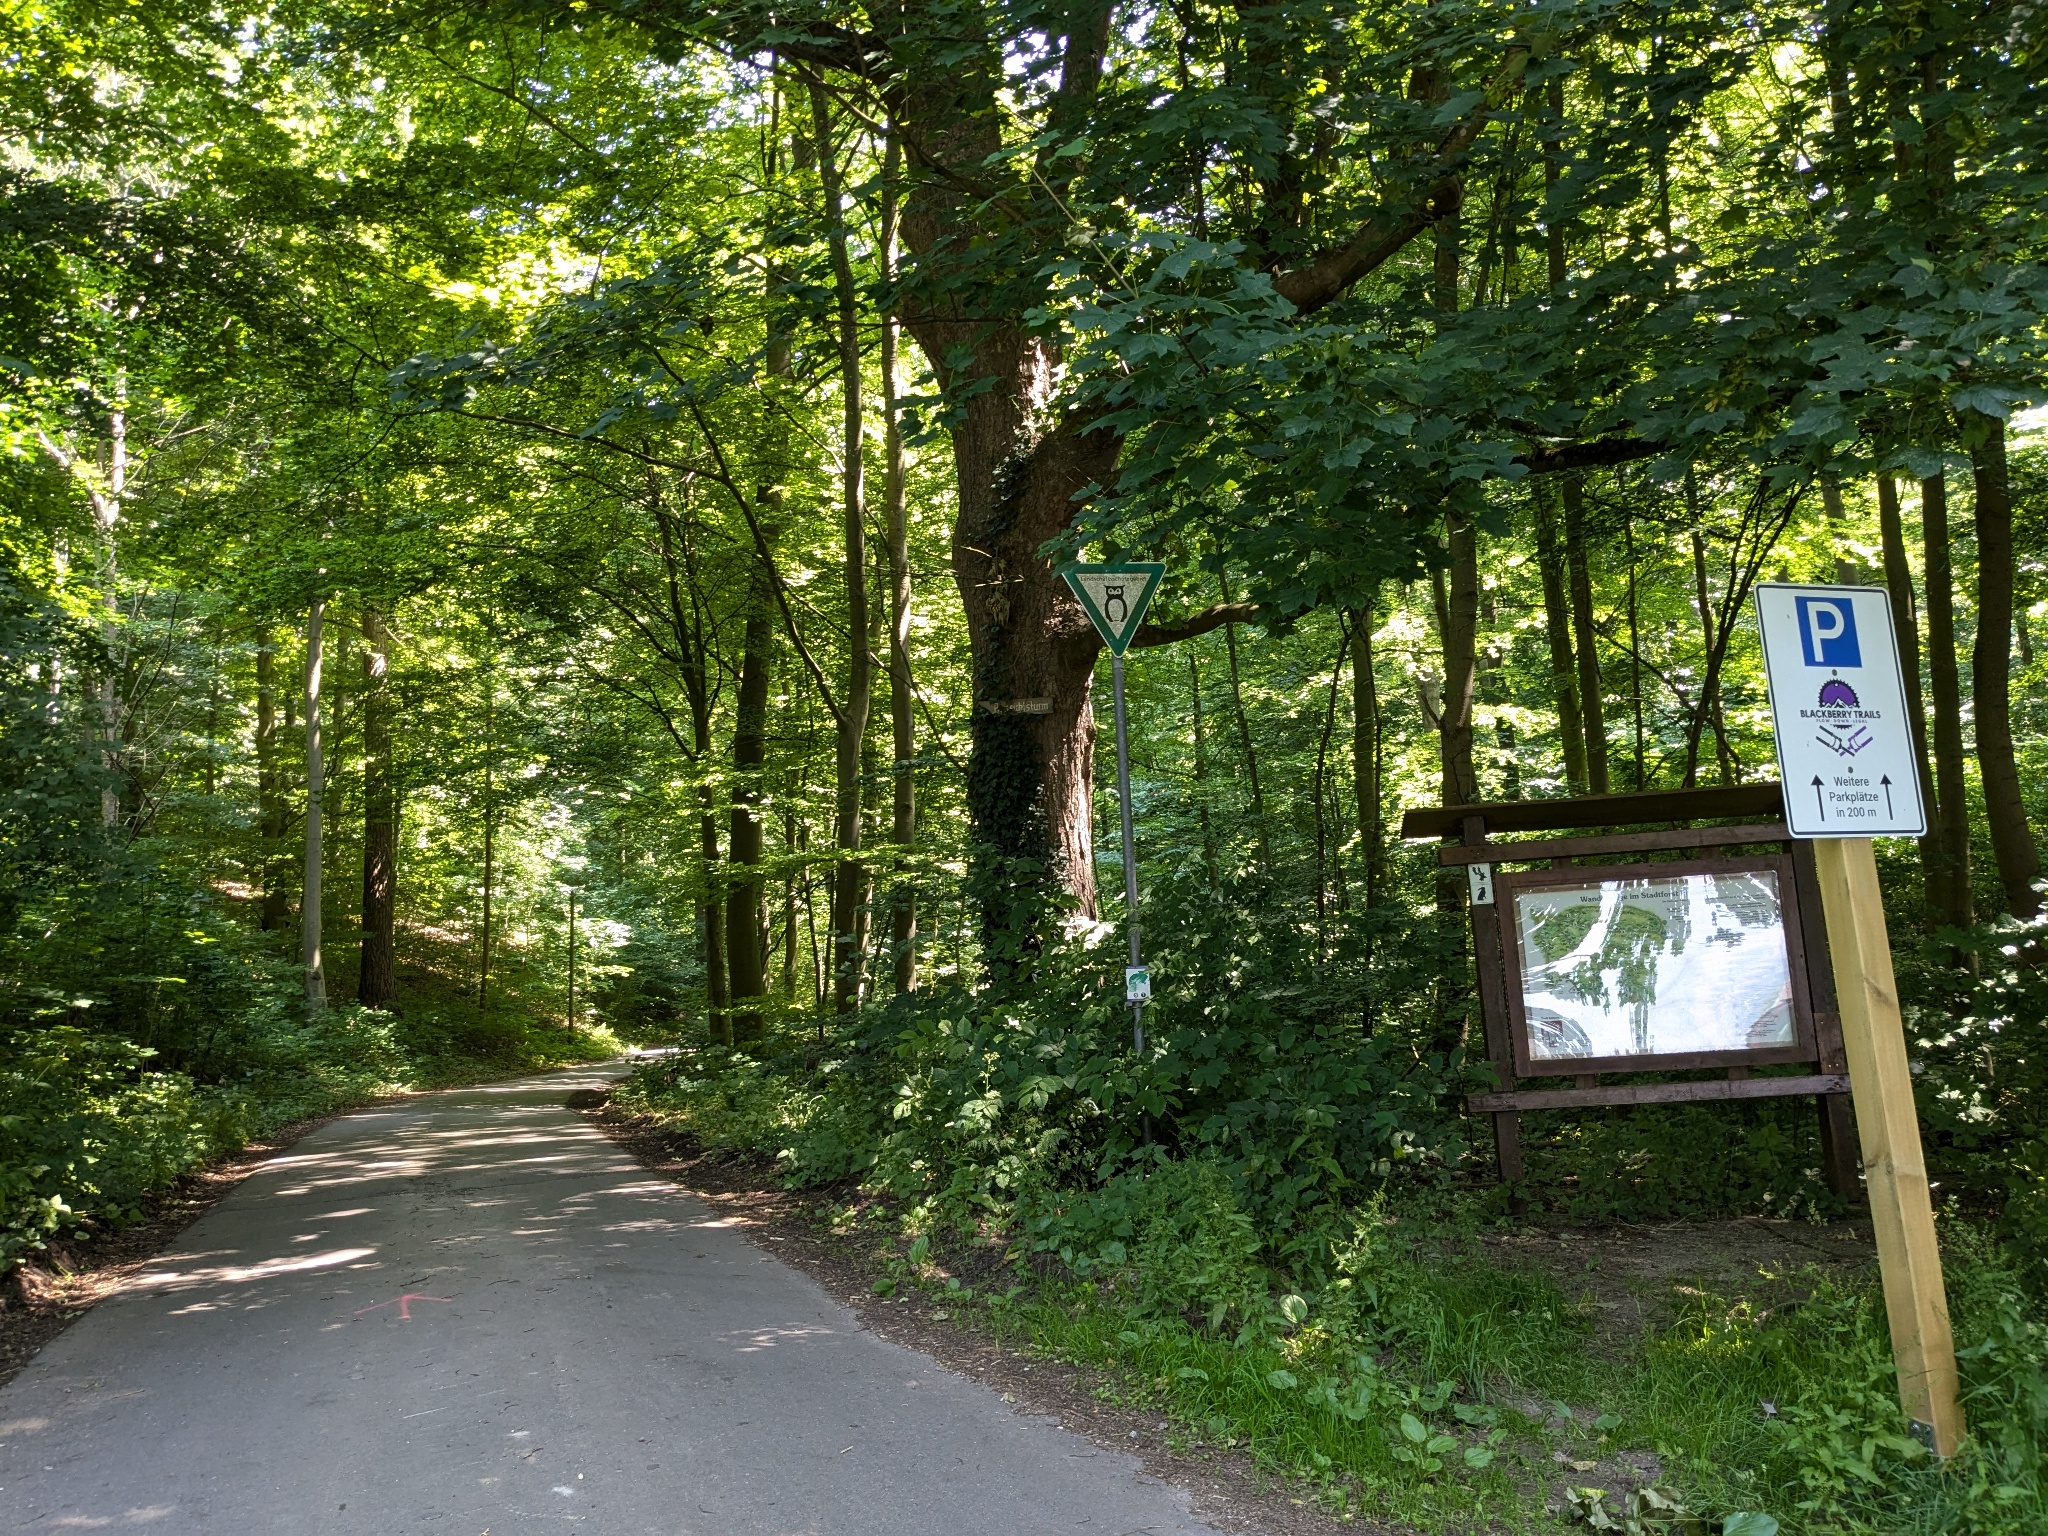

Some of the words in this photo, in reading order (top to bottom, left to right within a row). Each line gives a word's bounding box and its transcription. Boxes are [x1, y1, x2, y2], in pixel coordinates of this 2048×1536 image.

[1806, 601, 1845, 662] P
[1800, 709, 1852, 719] BLACKBERRY
[1853, 710, 1881, 719] TRAILS
[1833, 776, 1869, 787] Weitere
[1829, 791, 1879, 804] Parkplätze
[1835, 807, 1845, 817] in
[1847, 807, 1865, 817] 200
[1867, 809, 1877, 817] m
[1641, 890, 1678, 899] Stadtforst
